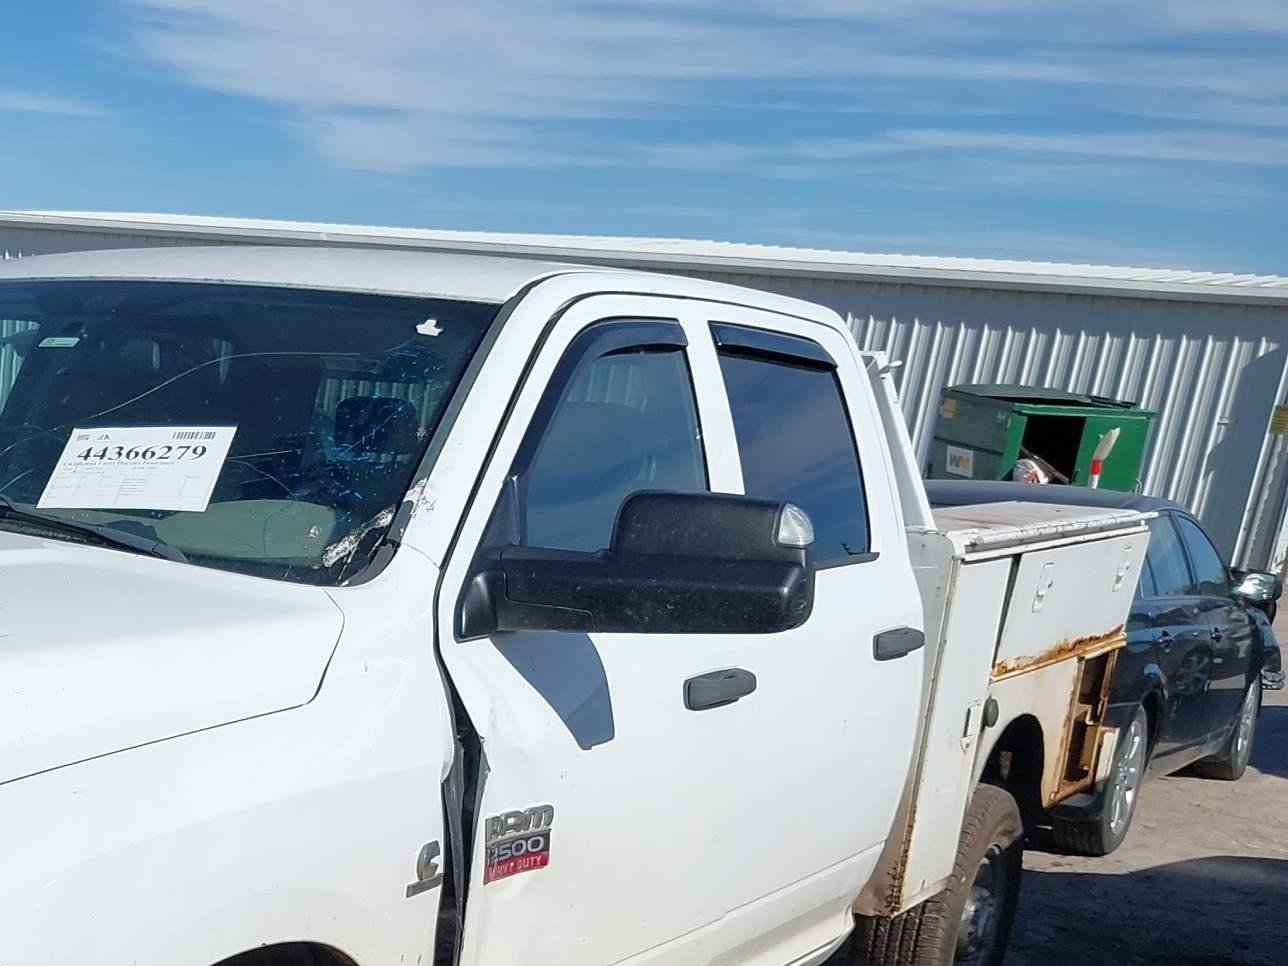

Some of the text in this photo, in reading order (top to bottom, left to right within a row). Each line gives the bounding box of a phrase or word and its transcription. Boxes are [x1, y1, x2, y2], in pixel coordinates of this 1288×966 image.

[76, 445, 207, 461] 44366279
[485, 804, 554, 837] RAM
[518, 855, 543, 869] DUTY
